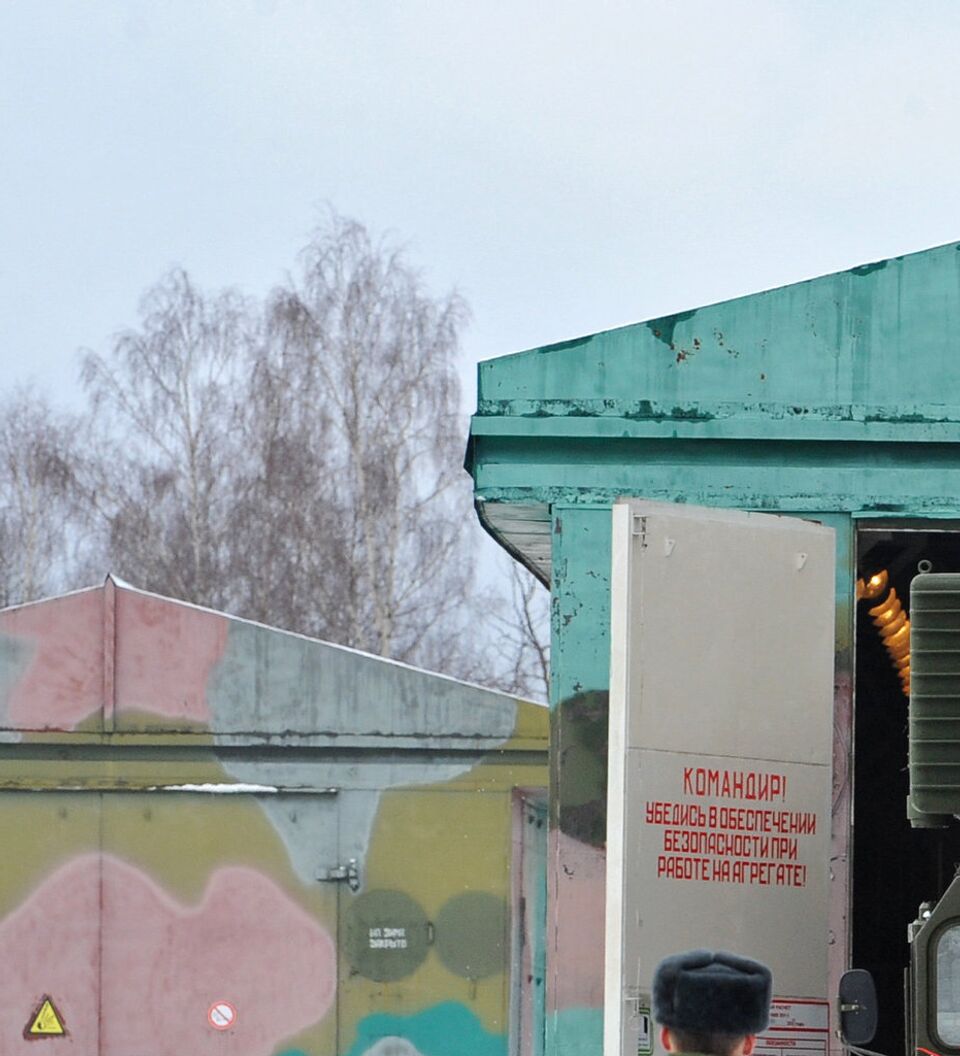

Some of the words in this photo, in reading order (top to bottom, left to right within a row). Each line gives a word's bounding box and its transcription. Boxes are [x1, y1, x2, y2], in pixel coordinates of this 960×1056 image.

[683, 767, 786, 802] КОМАНДИР!
[645, 801, 706, 827] УБЕДИСЬ
[708, 805, 717, 829] В
[719, 806, 816, 835] ОБЕСПЕЧЕНИИ
[663, 829, 769, 860] БЕЗОПАСНОСТИ
[770, 836, 798, 861] ПРИ
[657, 855, 710, 882] РАБОТЕ
[712, 859, 731, 883] НА
[732, 861, 807, 888] АГРЕГАТЕ!
